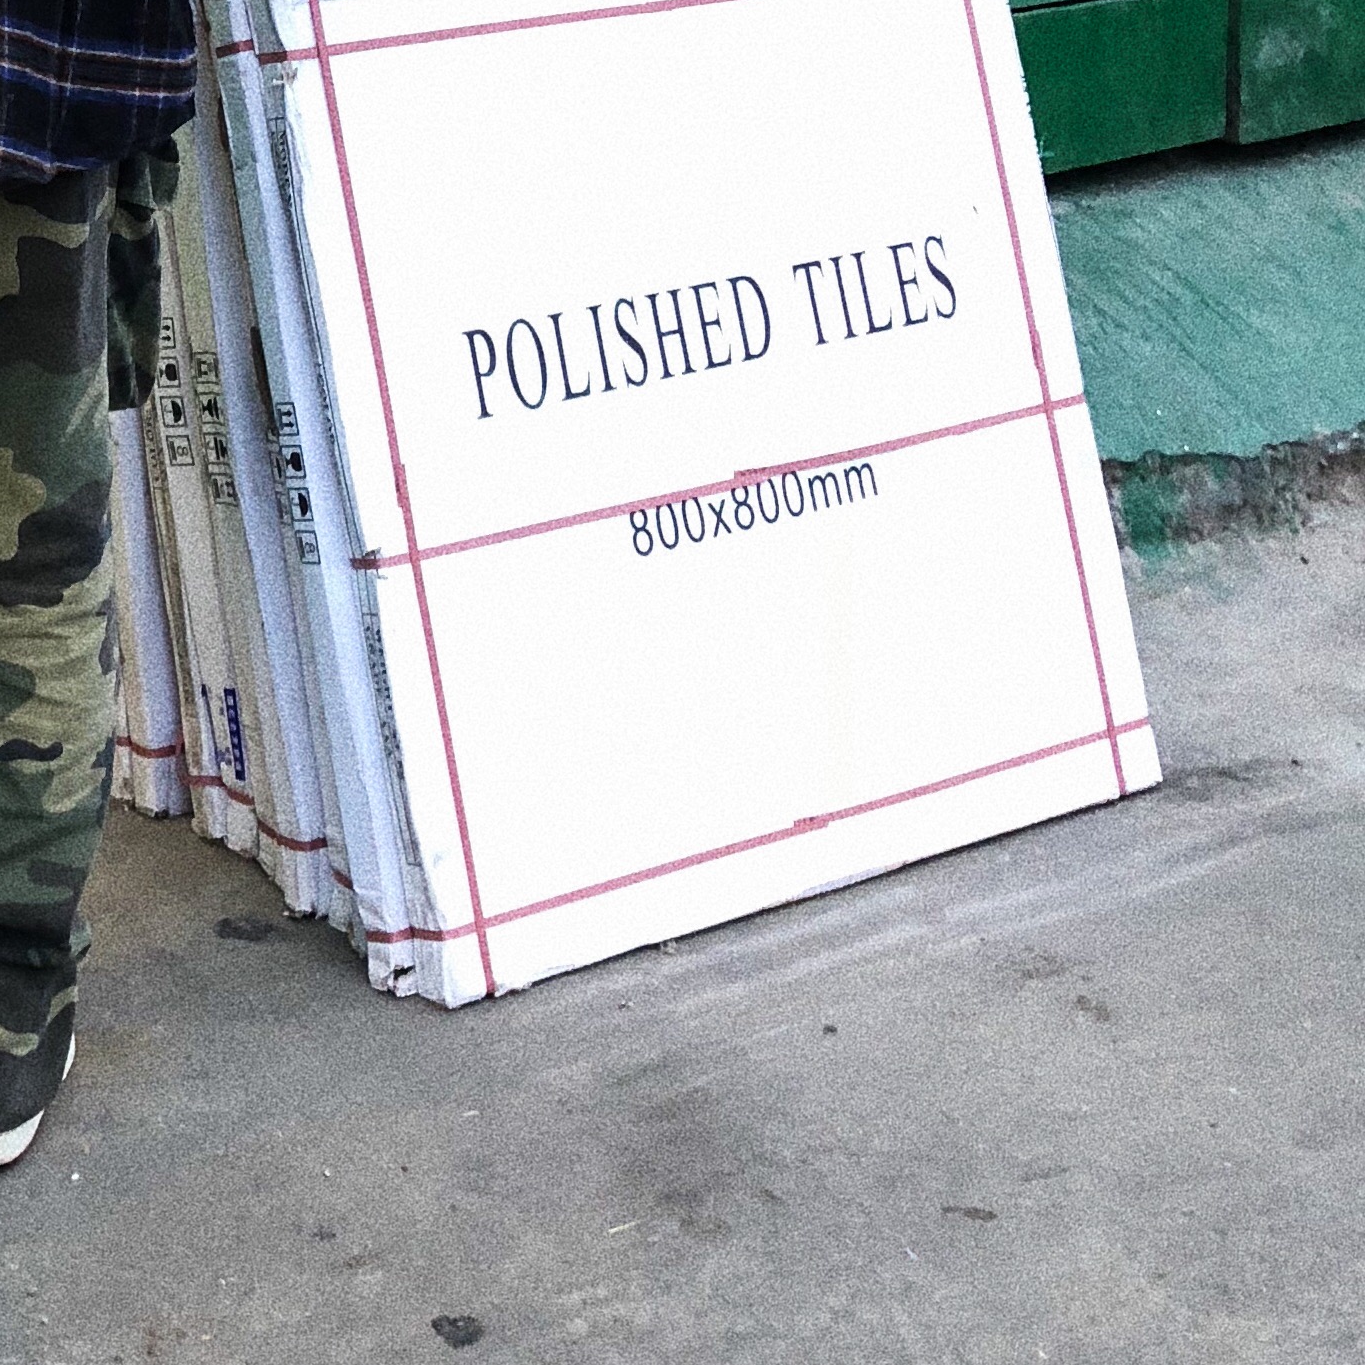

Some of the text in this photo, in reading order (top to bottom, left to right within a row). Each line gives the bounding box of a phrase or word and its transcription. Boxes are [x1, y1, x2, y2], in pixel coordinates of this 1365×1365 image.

[462, 274, 772, 420] POLISHED
[792, 234, 959, 347] TILES
[628, 461, 879, 557] 800x800mm
